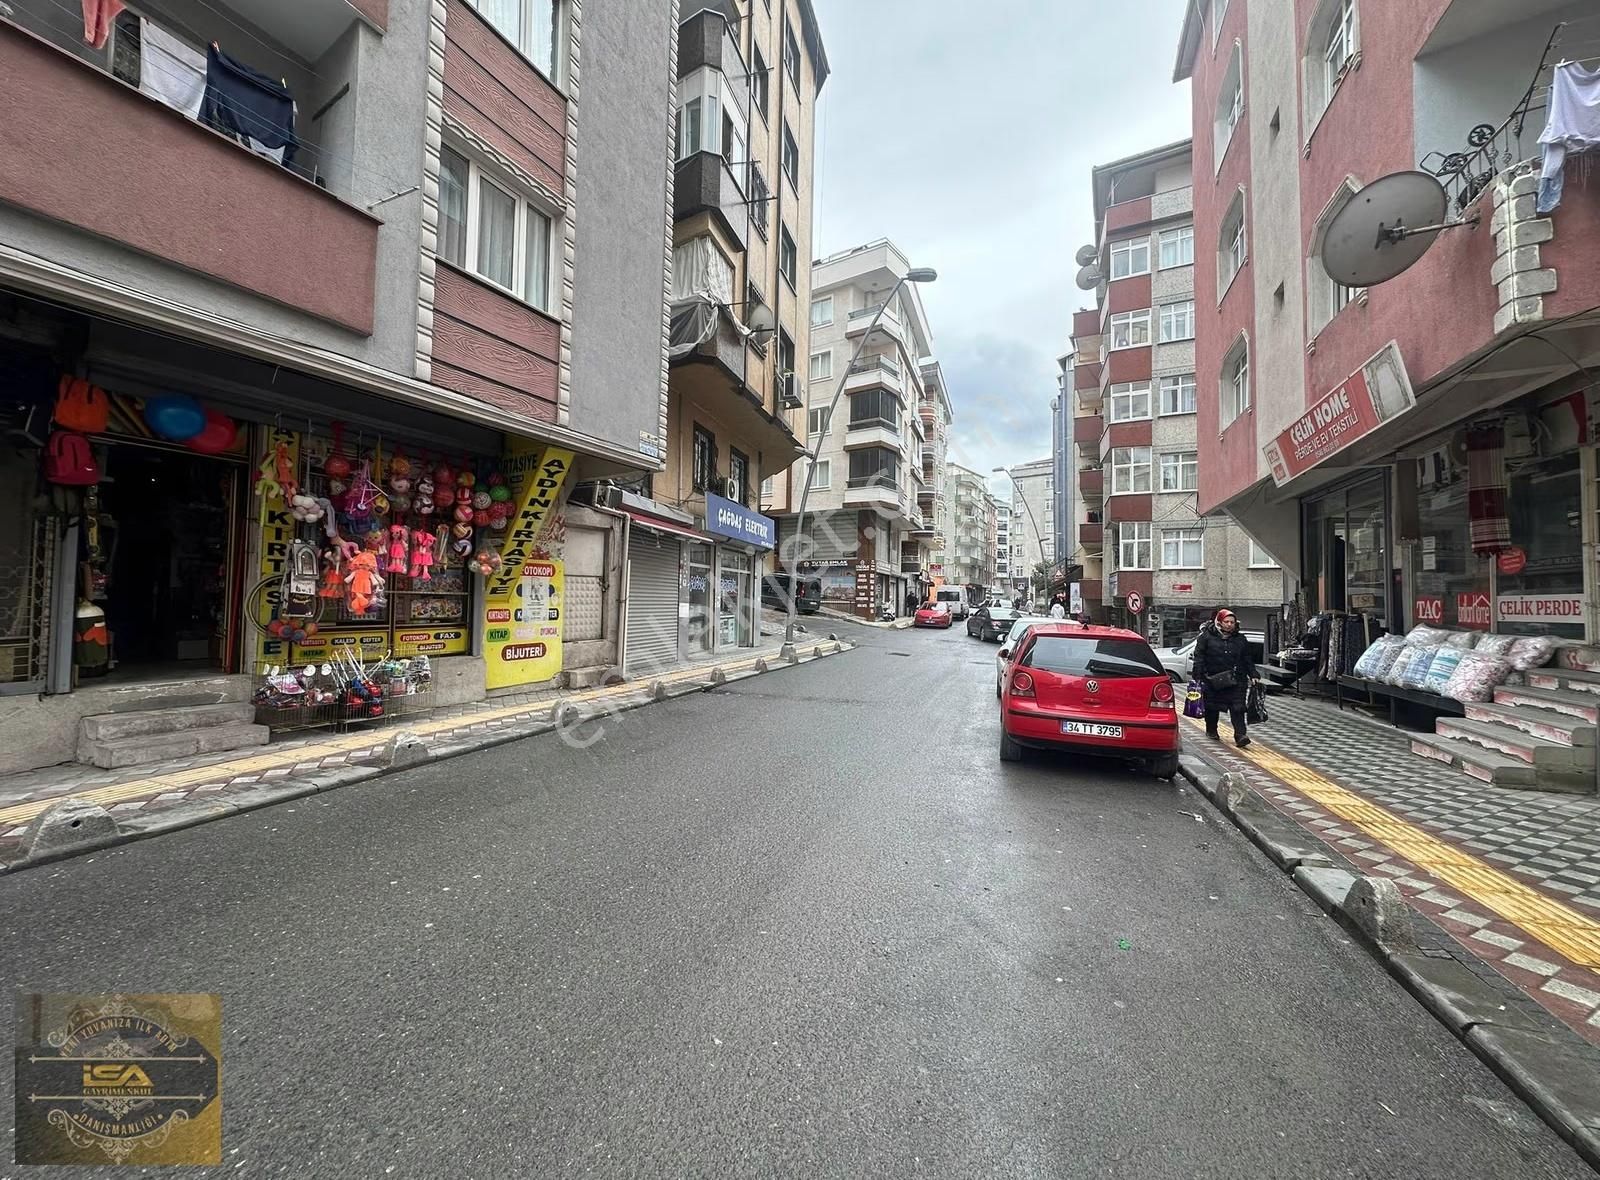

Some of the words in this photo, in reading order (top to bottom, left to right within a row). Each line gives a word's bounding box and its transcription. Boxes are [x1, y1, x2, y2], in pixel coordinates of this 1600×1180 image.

[1314, 387, 1350, 429] HOME
[1295, 442, 1314, 461] PERDE
[1312, 436, 1321, 449] VE
[1320, 430, 1329, 445] EV
[1328, 408, 1359, 438] TEKSTİLİ
[502, 453, 538, 473] RTASİYE
[528, 459, 565, 508] AYDIN
[718, 508, 742, 534] ÇAĞDAŞ
[264, 511, 290, 655] KIRTASİE
[1416, 600, 1441, 622] TAÇ
[1500, 597, 1533, 621] ÇELİK
[1536, 600, 1582, 616] PERDE
[489, 628, 508, 639] KİTAP
[505, 643, 543, 660] BİJUTERİ
[1068, 722, 1079, 732] 34
[1082, 723, 1094, 733] TT
[1096, 725, 1121, 736] 3795
